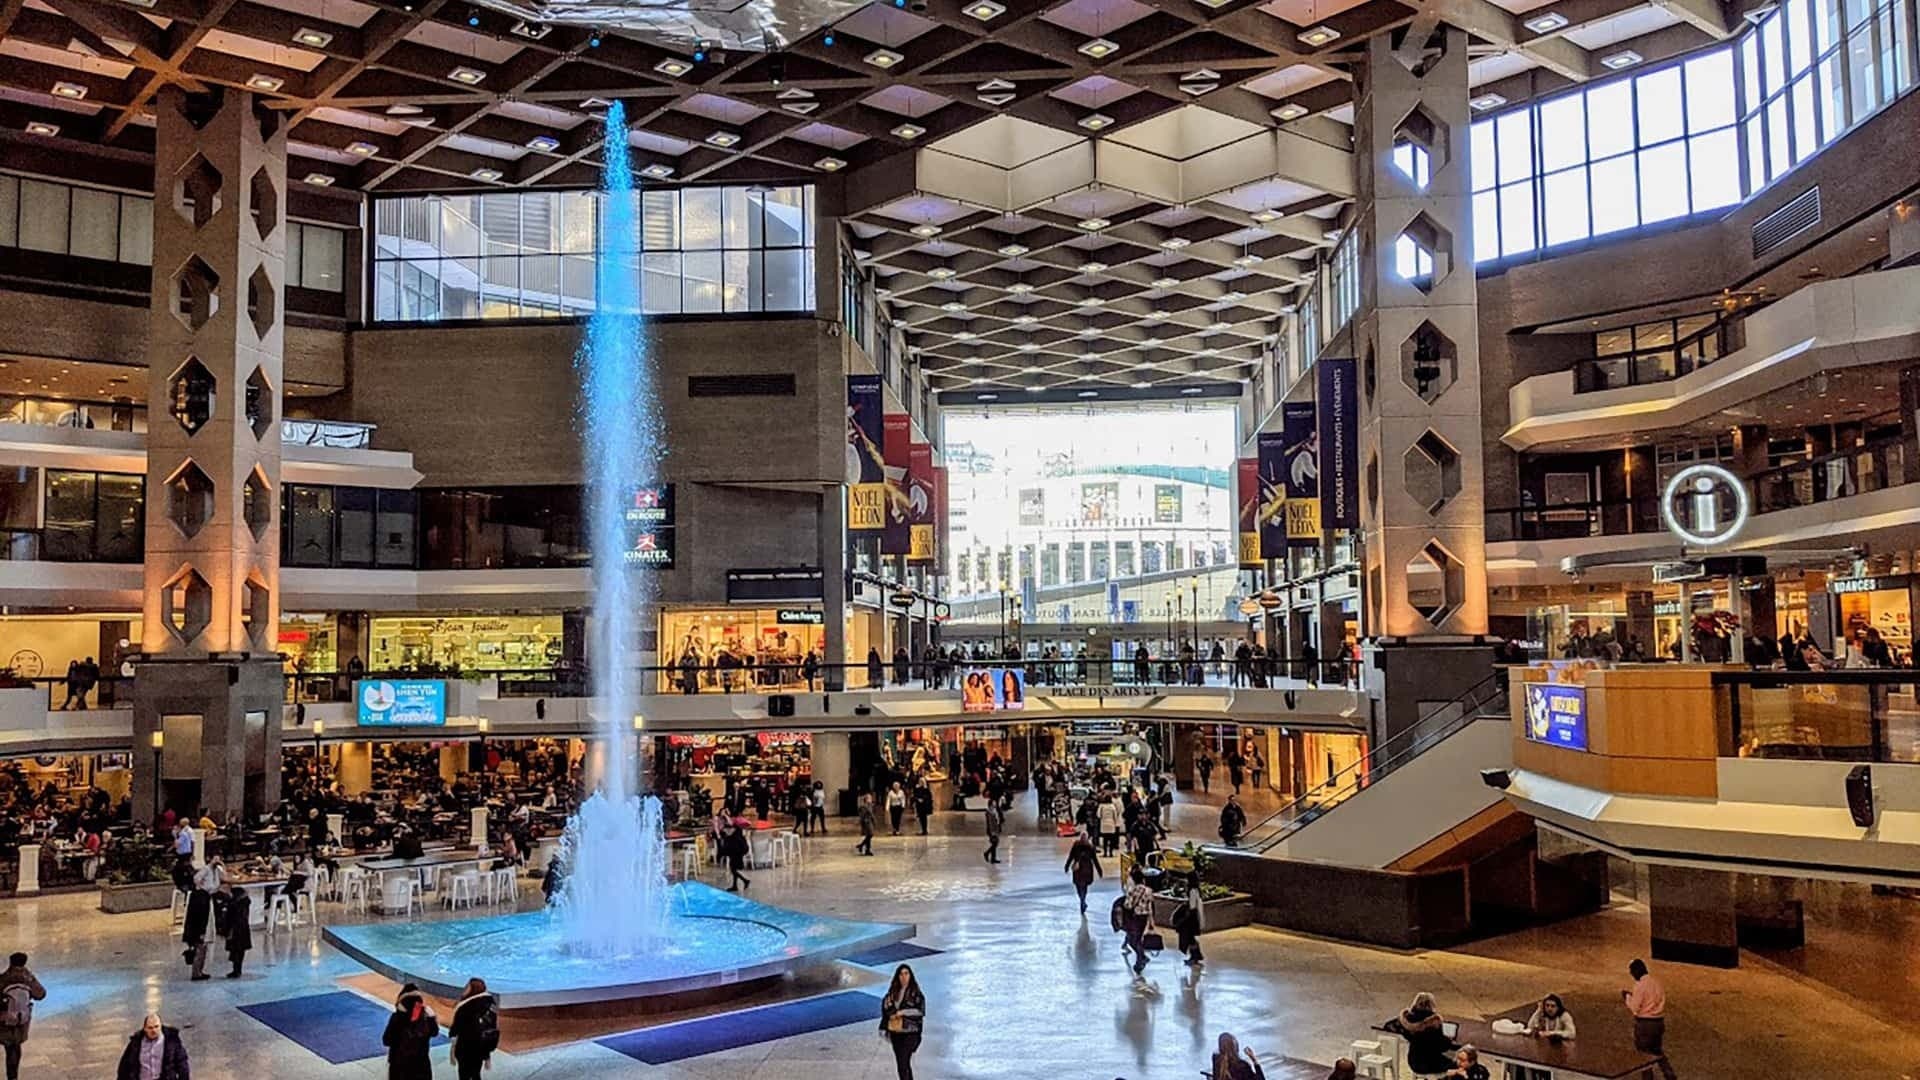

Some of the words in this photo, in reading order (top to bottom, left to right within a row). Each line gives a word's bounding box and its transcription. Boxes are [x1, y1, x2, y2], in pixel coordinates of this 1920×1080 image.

[1334, 422, 1343, 472] RESTAURANTS
[1336, 477, 1344, 519] BOUTIQUES
[624, 550, 668, 559] KINATEX
[1052, 687, 1086, 697] PLACE
[1089, 687, 1110, 697] DES
[1112, 687, 1140, 697] ARTS
